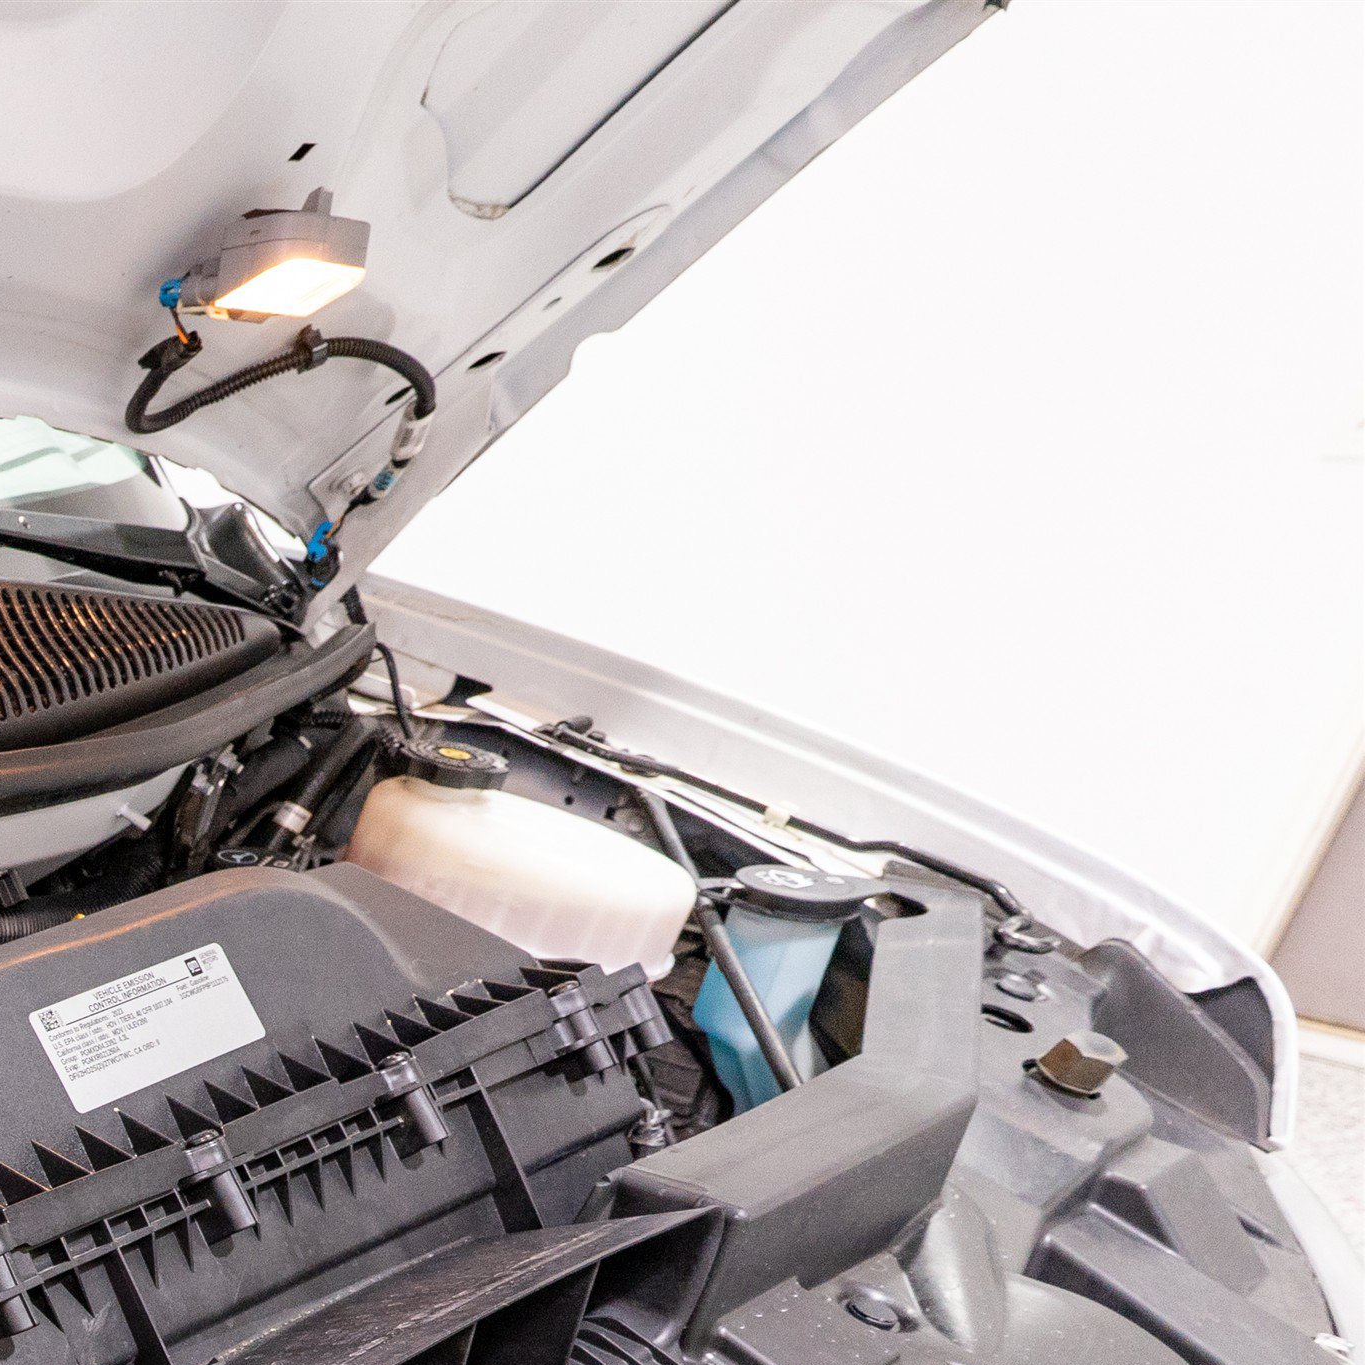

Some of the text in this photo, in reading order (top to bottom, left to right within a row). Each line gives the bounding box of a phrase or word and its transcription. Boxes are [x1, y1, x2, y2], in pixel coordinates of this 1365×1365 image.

[87, 976, 167, 1012] CONTROL INFORMATION
[92, 971, 155, 1000] VEHICLE EMISSION
